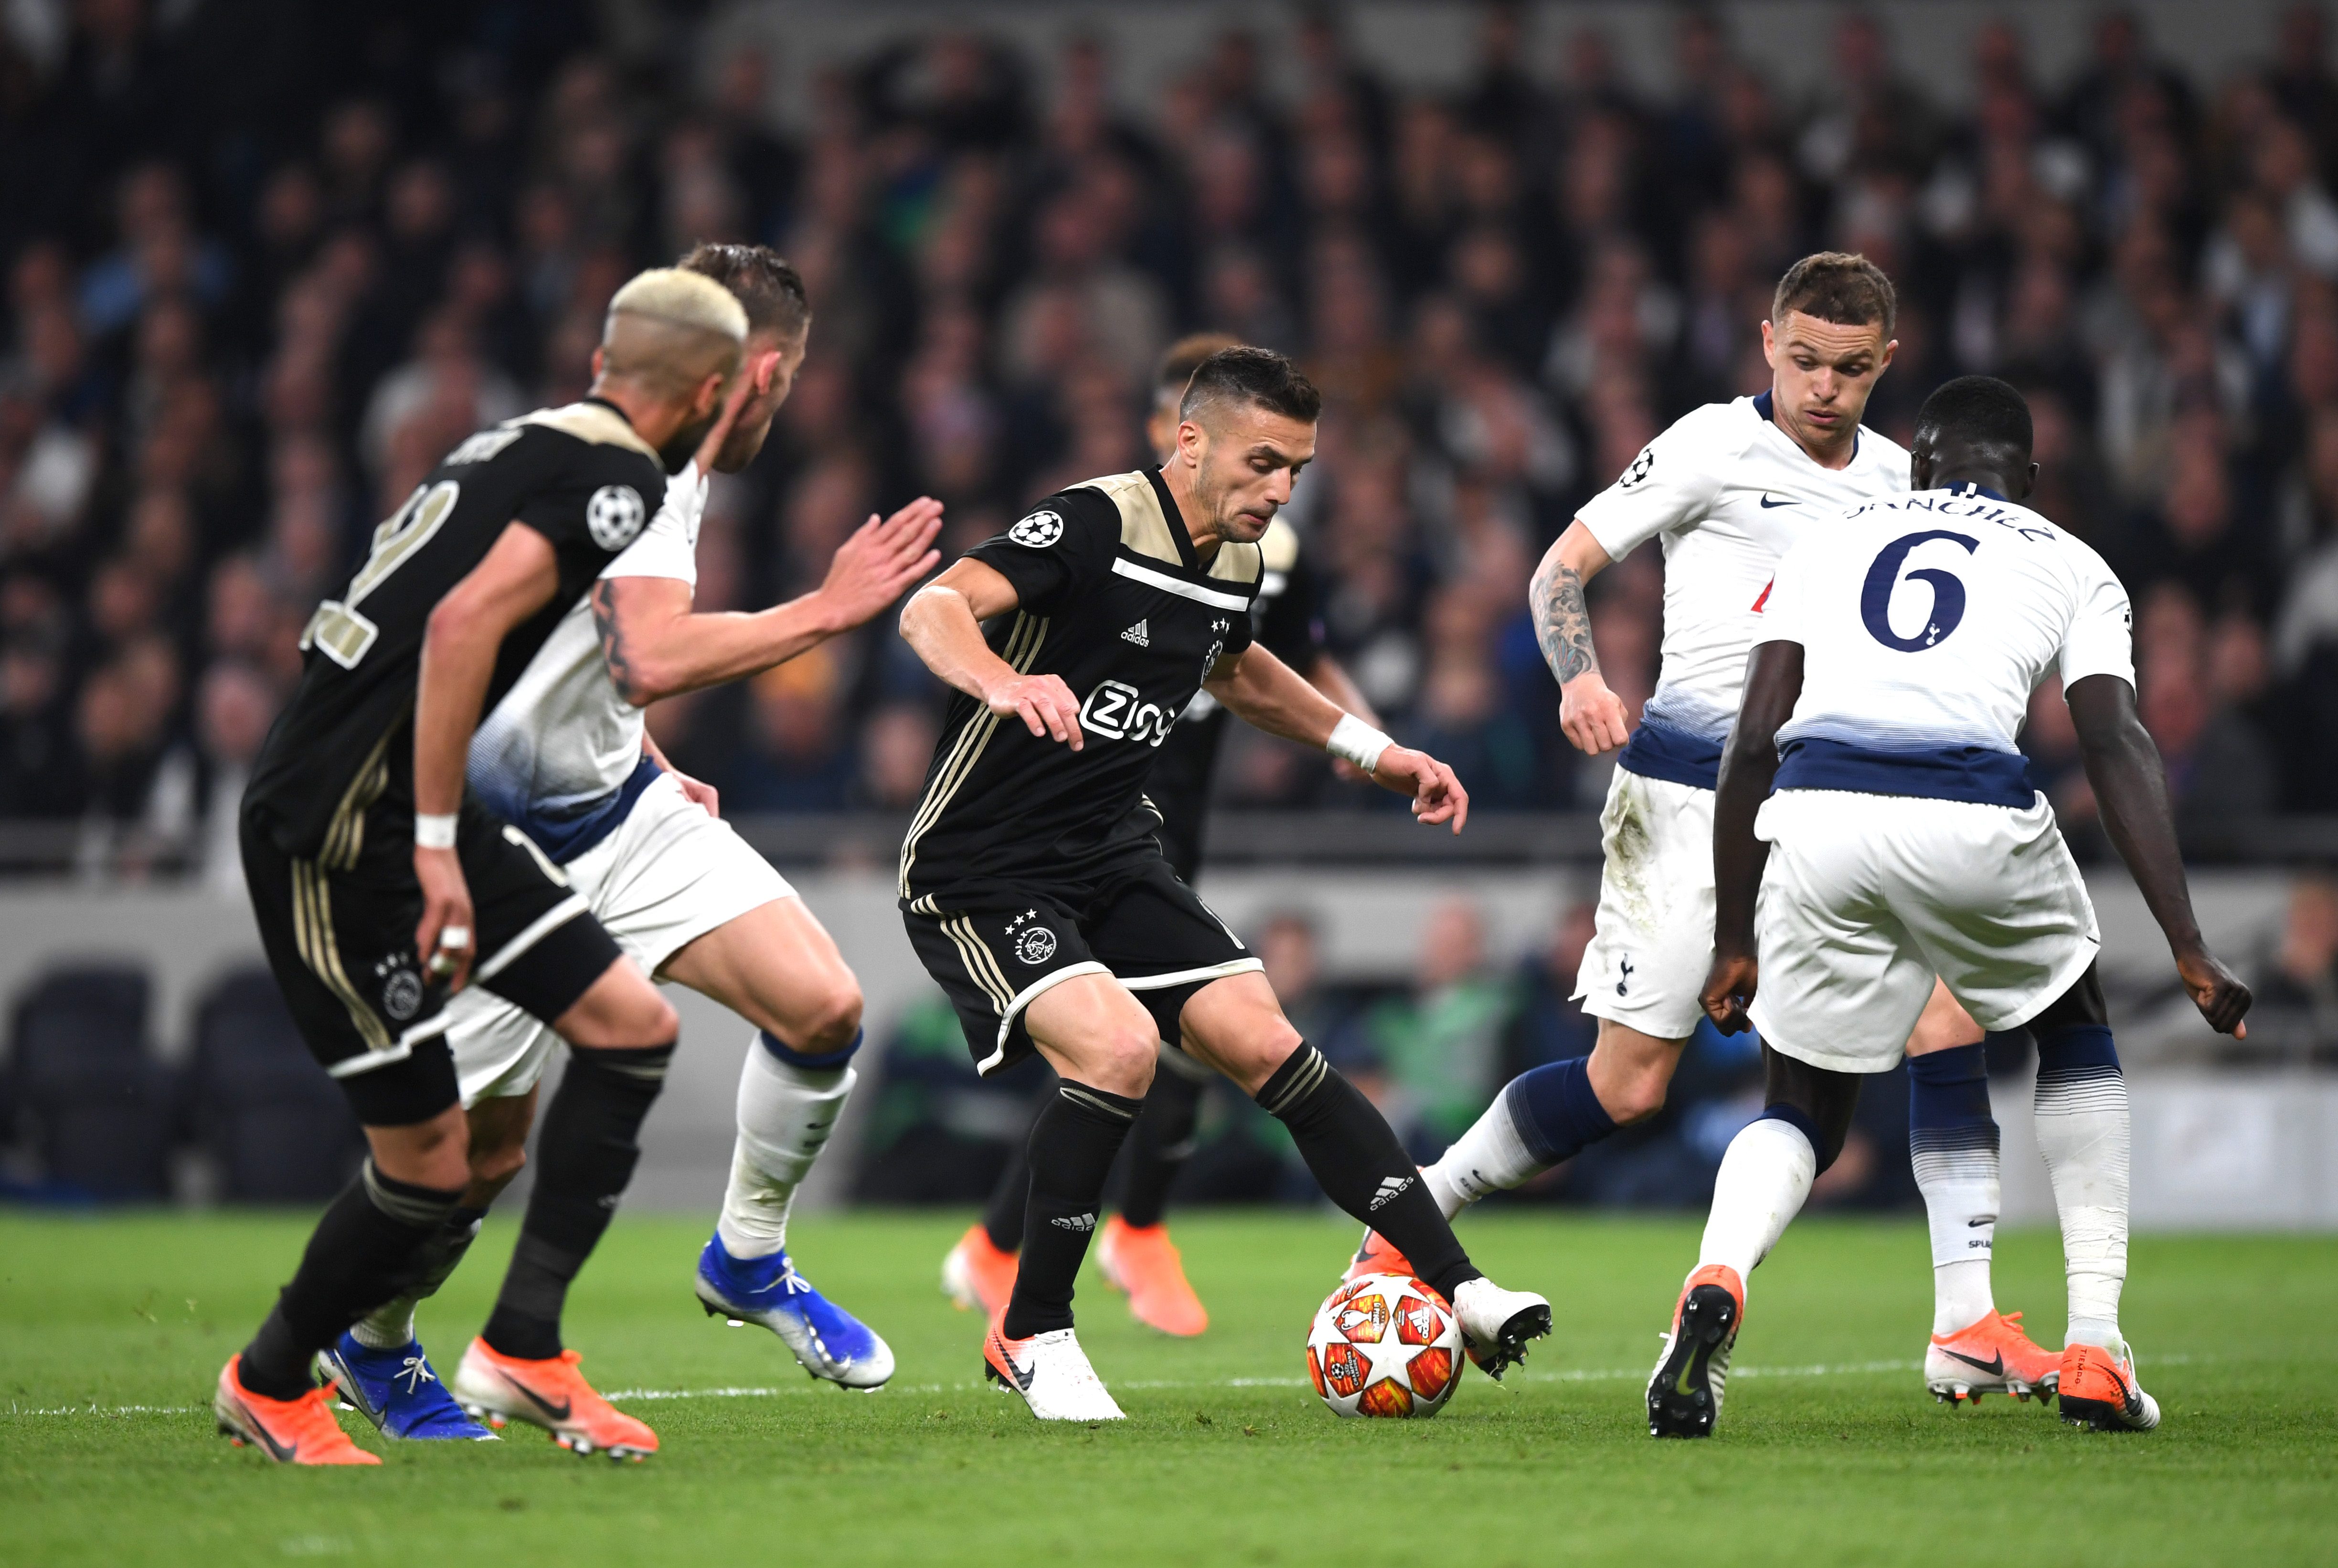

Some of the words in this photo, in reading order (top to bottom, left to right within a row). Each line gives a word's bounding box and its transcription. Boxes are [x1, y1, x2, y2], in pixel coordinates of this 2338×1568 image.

[1860, 530, 1980, 653] 6
[1121, 632, 1149, 647] adidas
[1079, 679, 1176, 747] Zigg
[1015, 932, 1028, 955] AJAX
[1370, 1176, 1414, 1211] adidas
[1051, 1219, 1097, 1232] adida
[1347, 1351, 1359, 1386] CHAMPIONS
[2075, 1349, 2087, 1384] TIEMPO
